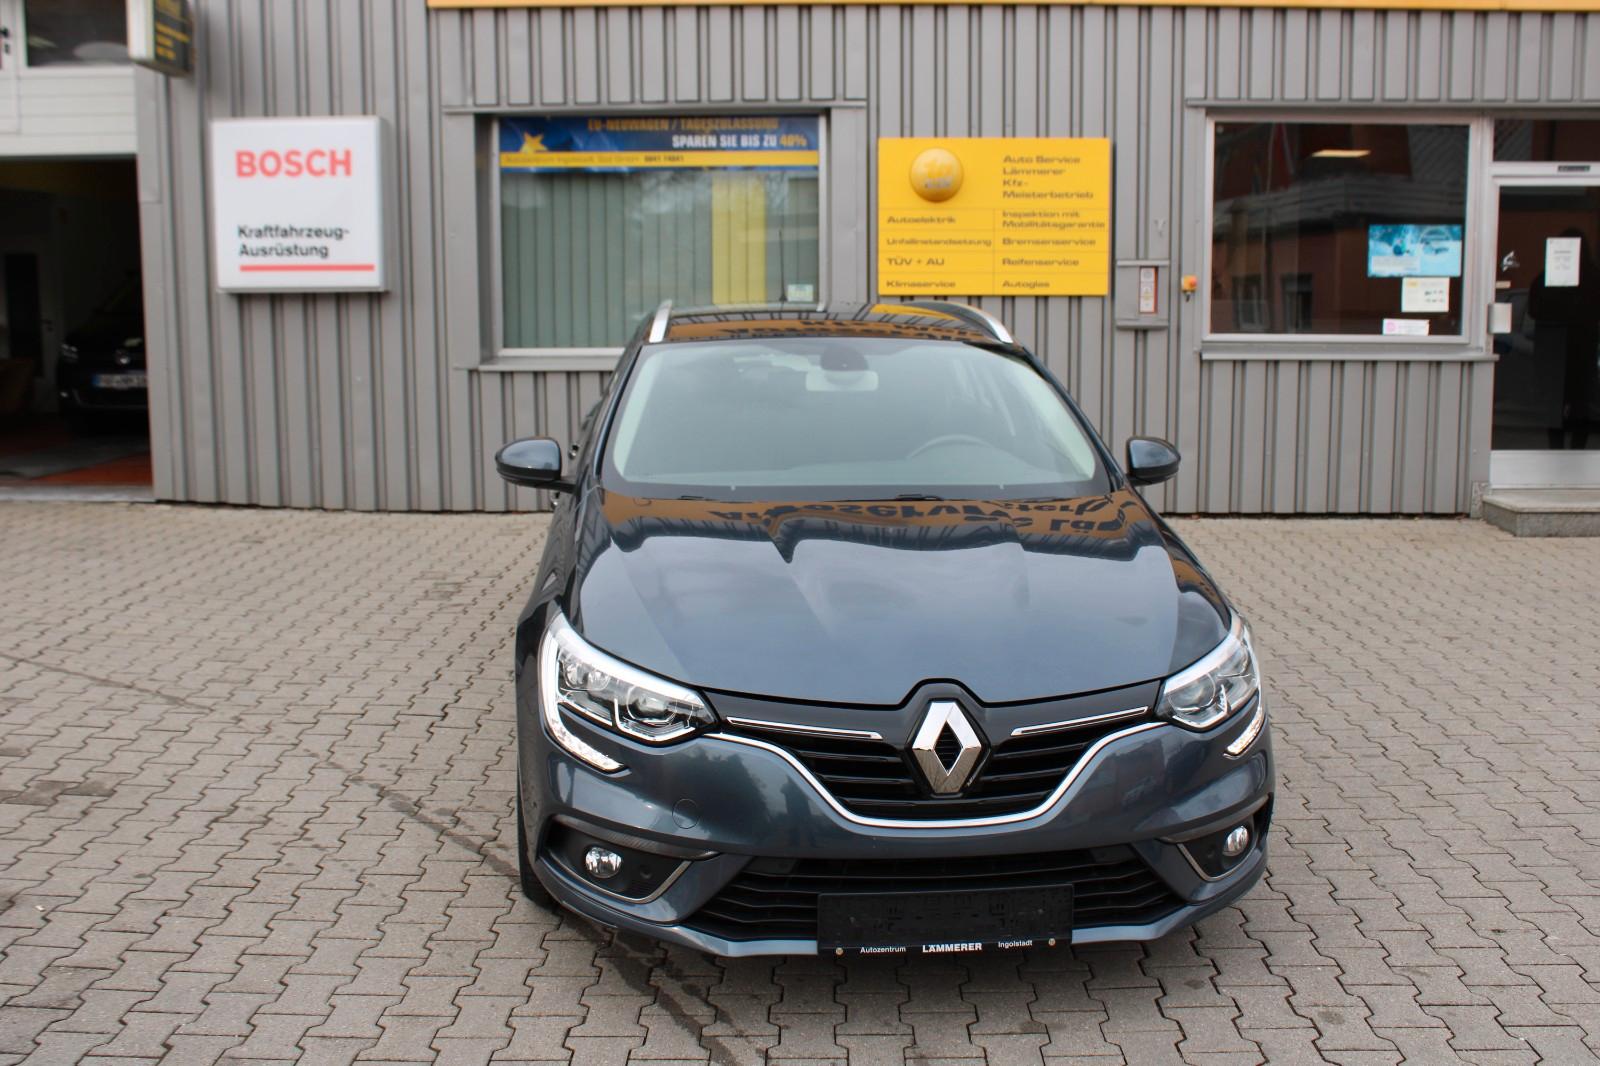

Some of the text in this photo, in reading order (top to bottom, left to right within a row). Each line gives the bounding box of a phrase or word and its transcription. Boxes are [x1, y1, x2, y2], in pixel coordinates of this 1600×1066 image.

[672, 133, 807, 148] SPAREN SIE BIS ZU 40%
[235, 149, 352, 177] BOSCH
[1002, 190, 1094, 199] Meisterbetrieb
[1002, 210, 1060, 219] Inspektion
[887, 215, 956, 225] Autoelektrik
[1002, 219, 1105, 230] Mobilitätsgarantie
[238, 224, 350, 241] Kraftfahrzeug-
[1002, 237, 1096, 246] Bremsenservice
[239, 243, 329, 259] Ausrüstung
[886, 256, 913, 266] TÜV
[926, 256, 945, 266] AU
[1002, 257, 1080, 267] Reifenservice
[886, 279, 957, 289] Klimaservice
[1002, 279, 1051, 290] Autoglas
[859, 939, 1033, 955] Autozentrum LÄMMERER Ingolstadt
